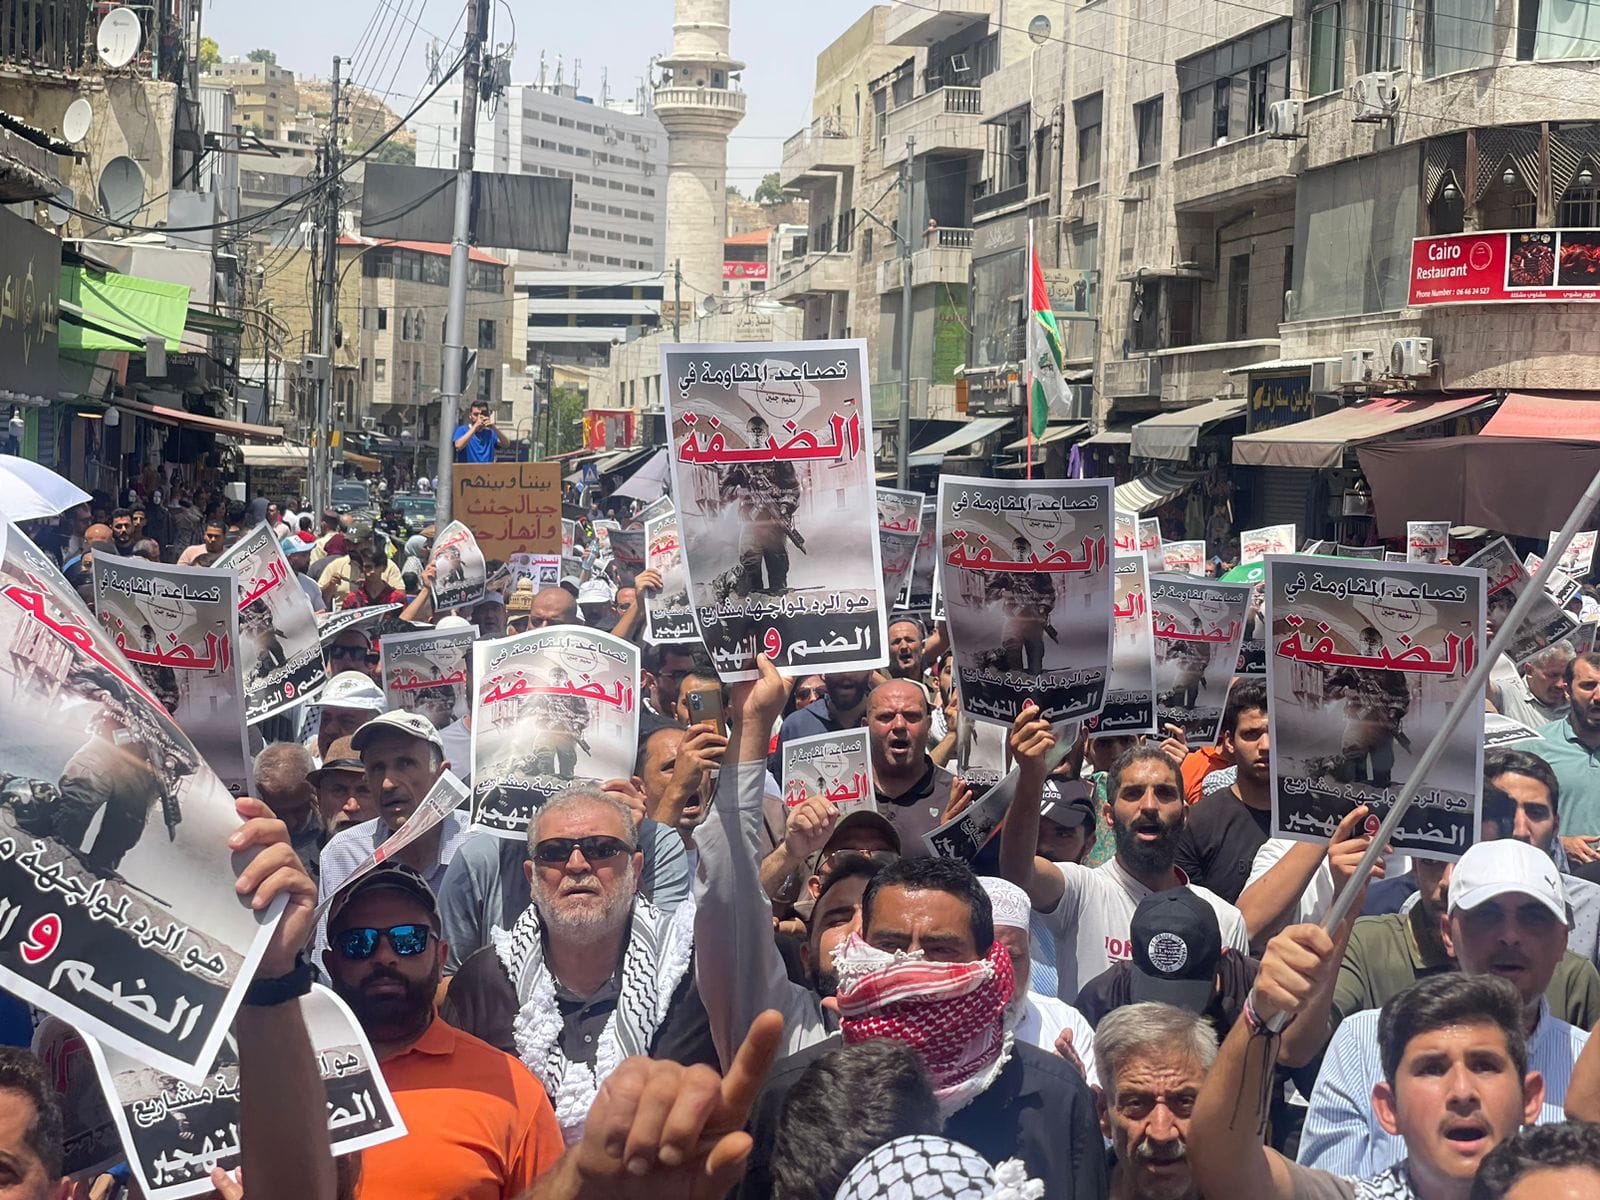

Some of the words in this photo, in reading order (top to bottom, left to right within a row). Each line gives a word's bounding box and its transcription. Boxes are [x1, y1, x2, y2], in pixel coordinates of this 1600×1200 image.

[1428, 242, 1461, 261] Cairo
[1416, 263, 1468, 280] Restaurant
[1416, 290, 1430, 298] Phone
[679, 361, 697, 397] في
[700, 361, 768, 390] المقاومة
[774, 361, 848, 381] تصاعد
[678, 409, 862, 465] الضفة
[952, 491, 968, 519] في
[972, 491, 1032, 516] المقاومة
[1038, 495, 1099, 513] تصاعد
[946, 528, 1107, 573] الضفة
[110, 571, 157, 600] المقاومة
[161, 586, 220, 604] تصاعد
[1152, 585, 1165, 602] في
[1167, 586, 1209, 604] المقاومة
[1284, 571, 1307, 603] في
[1310, 573, 1386, 601] المقاومة
[1392, 585, 1467, 604] تصاعد
[811, 595, 842, 615] الرد
[845, 595, 869, 614] هو
[1210, 592, 1243, 603] تصاعد
[700, 597, 745, 628] مشاريع
[743, 597, 806, 620] لمواجهة
[655, 622, 694, 638] التهجير
[391, 645, 402, 661] في
[404, 641, 439, 655] المقاومة
[440, 637, 473, 650] تصاعد
[511, 637, 571, 657] المقاومة
[574, 639, 629, 665] تصاعد
[763, 626, 783, 660] و
[787, 625, 871, 667] الضم
[1276, 614, 1476, 677] الضفة
[490, 652, 508, 670] في
[962, 667, 1003, 687] مشاريع
[1004, 675, 1057, 693] لمواجهة
[1061, 671, 1082, 688] الرد
[1085, 672, 1101, 686] هو
[284, 681, 295, 698] و
[481, 671, 633, 713] الضفة
[1135, 692, 1148, 702] هو
[966, 696, 1017, 718] التهجير
[1040, 690, 1097, 721] الضم
[1089, 713, 1098, 729] و
[1101, 710, 1147, 731] الضم
[798, 745, 833, 763] المقاومة
[833, 739, 862, 756] تصاعد
[476, 777, 529, 795] مشاريع
[1283, 777, 1342, 799] مشاريع
[1343, 784, 1397, 808] واجهة
[1411, 790, 1440, 808] الرد
[1445, 796, 1468, 811] هو
[1363, 814, 1382, 838] و
[1394, 822, 1466, 847] الض
[16, 839, 133, 926] لمواجهة
[20, 913, 62, 964] و
[132, 916, 190, 952] الرد
[181, 945, 227, 976] هو
[48, 959, 204, 1041] الضم
[334, 1052, 360, 1077] هو
[132, 1082, 213, 1129] مشاريع
[326, 1088, 378, 1130] الض
